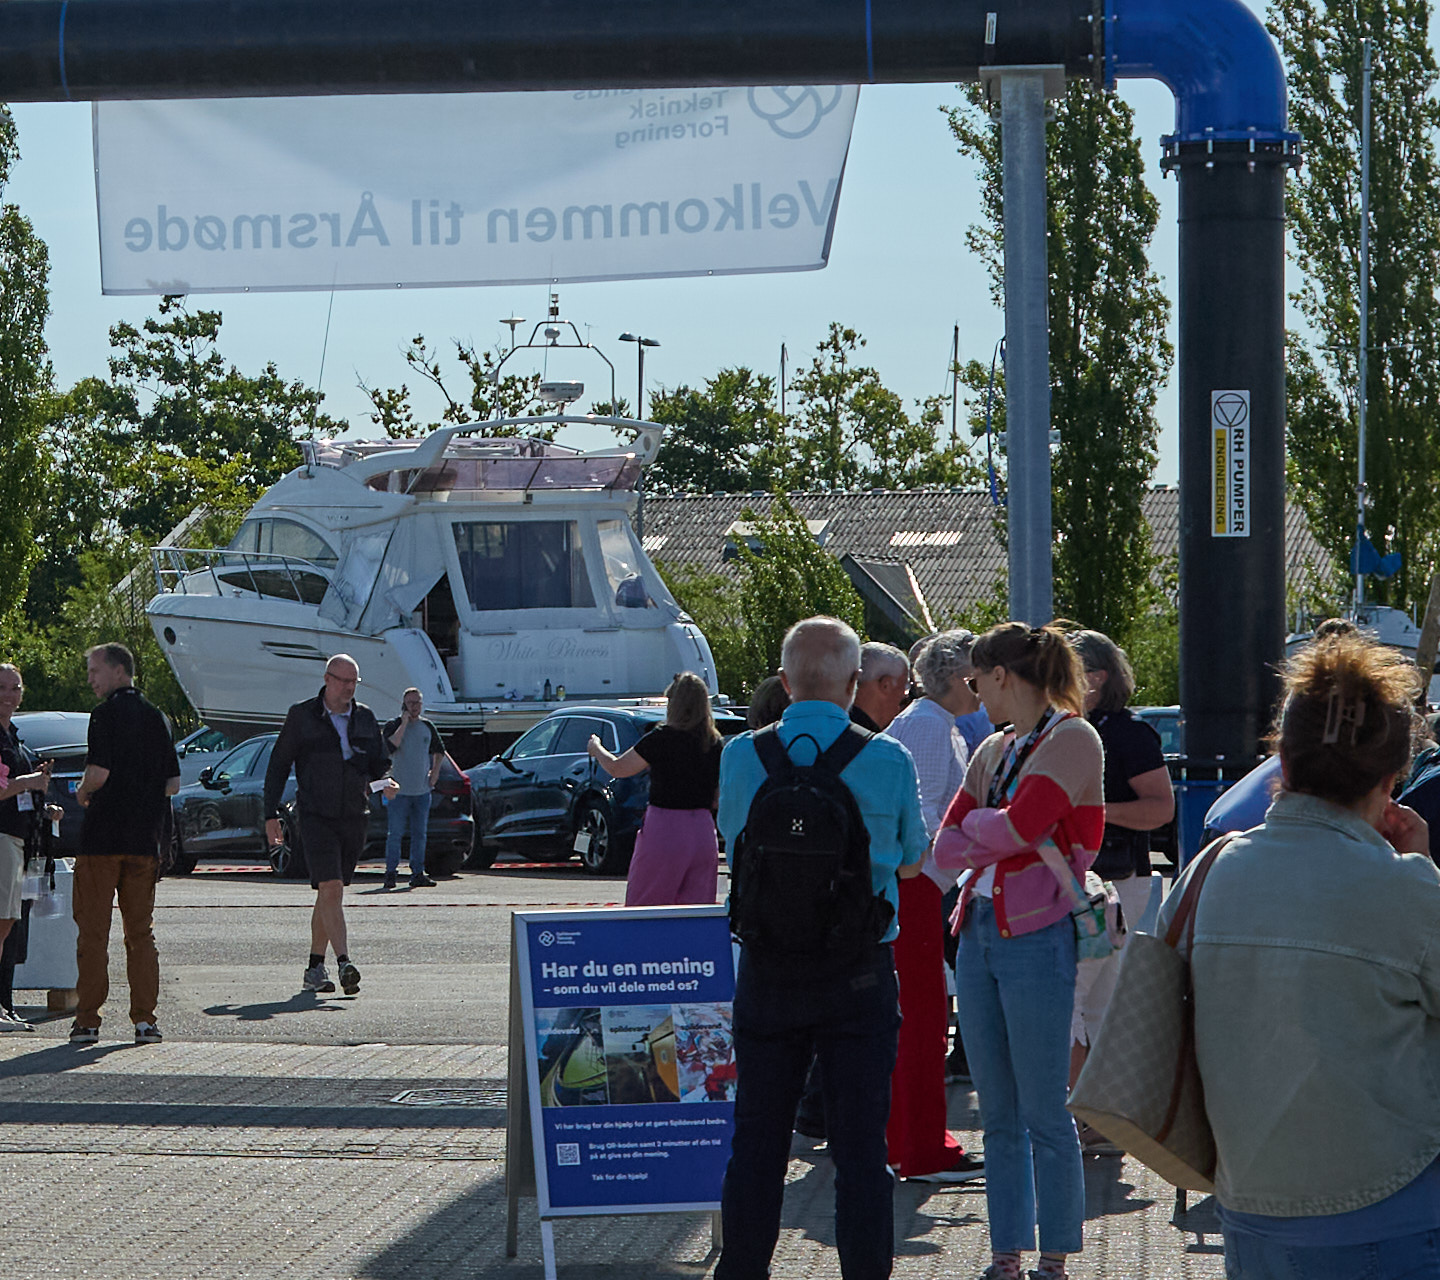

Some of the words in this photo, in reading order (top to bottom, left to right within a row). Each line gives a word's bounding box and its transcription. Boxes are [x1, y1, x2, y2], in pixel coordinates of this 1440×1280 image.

[1233, 428, 1245, 453] RH
[1215, 437, 1226, 525] ENGINEERING
[1233, 459, 1245, 533] PUMPER
[541, 962, 578, 979] Har
[583, 960, 608, 977] du
[612, 963, 637, 976] en
[642, 957, 715, 977] mening
[553, 985, 579, 994] som
[582, 983, 599, 994] du
[601, 982, 616, 993] vil
[619, 981, 645, 992] dele
[648, 980, 675, 991] med
[677, 980, 699, 991] os?
